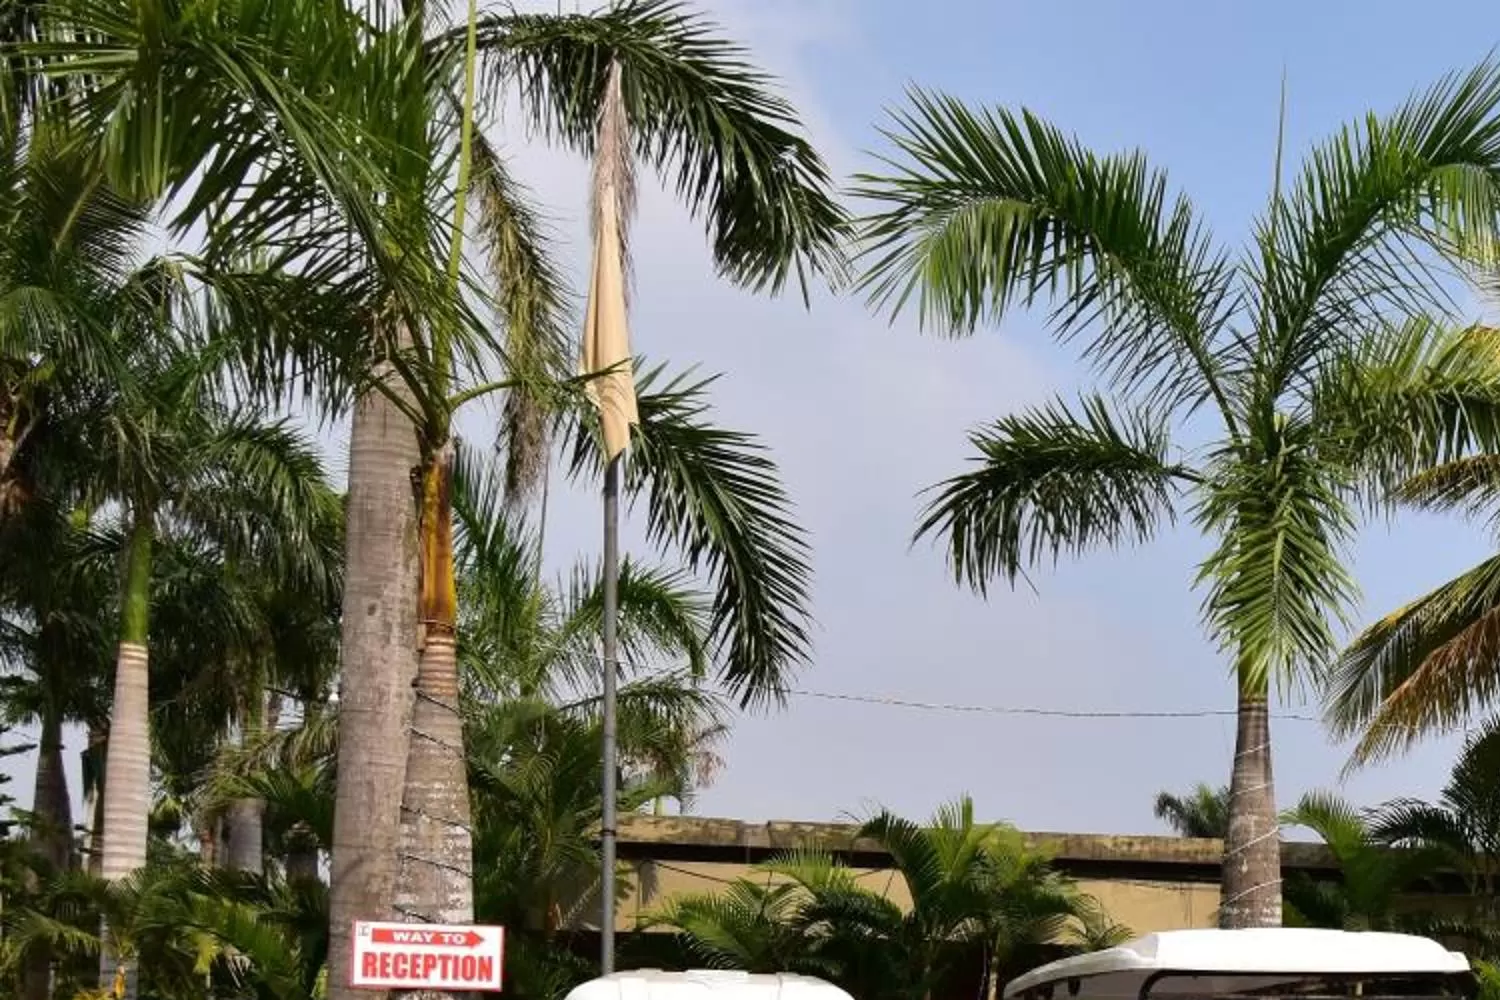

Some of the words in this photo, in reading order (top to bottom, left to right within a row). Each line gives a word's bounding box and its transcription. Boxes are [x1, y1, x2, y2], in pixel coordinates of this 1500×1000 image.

[393, 931, 434, 943] WAY
[441, 934, 466, 944] TO
[362, 951, 493, 982] RECEPTION
